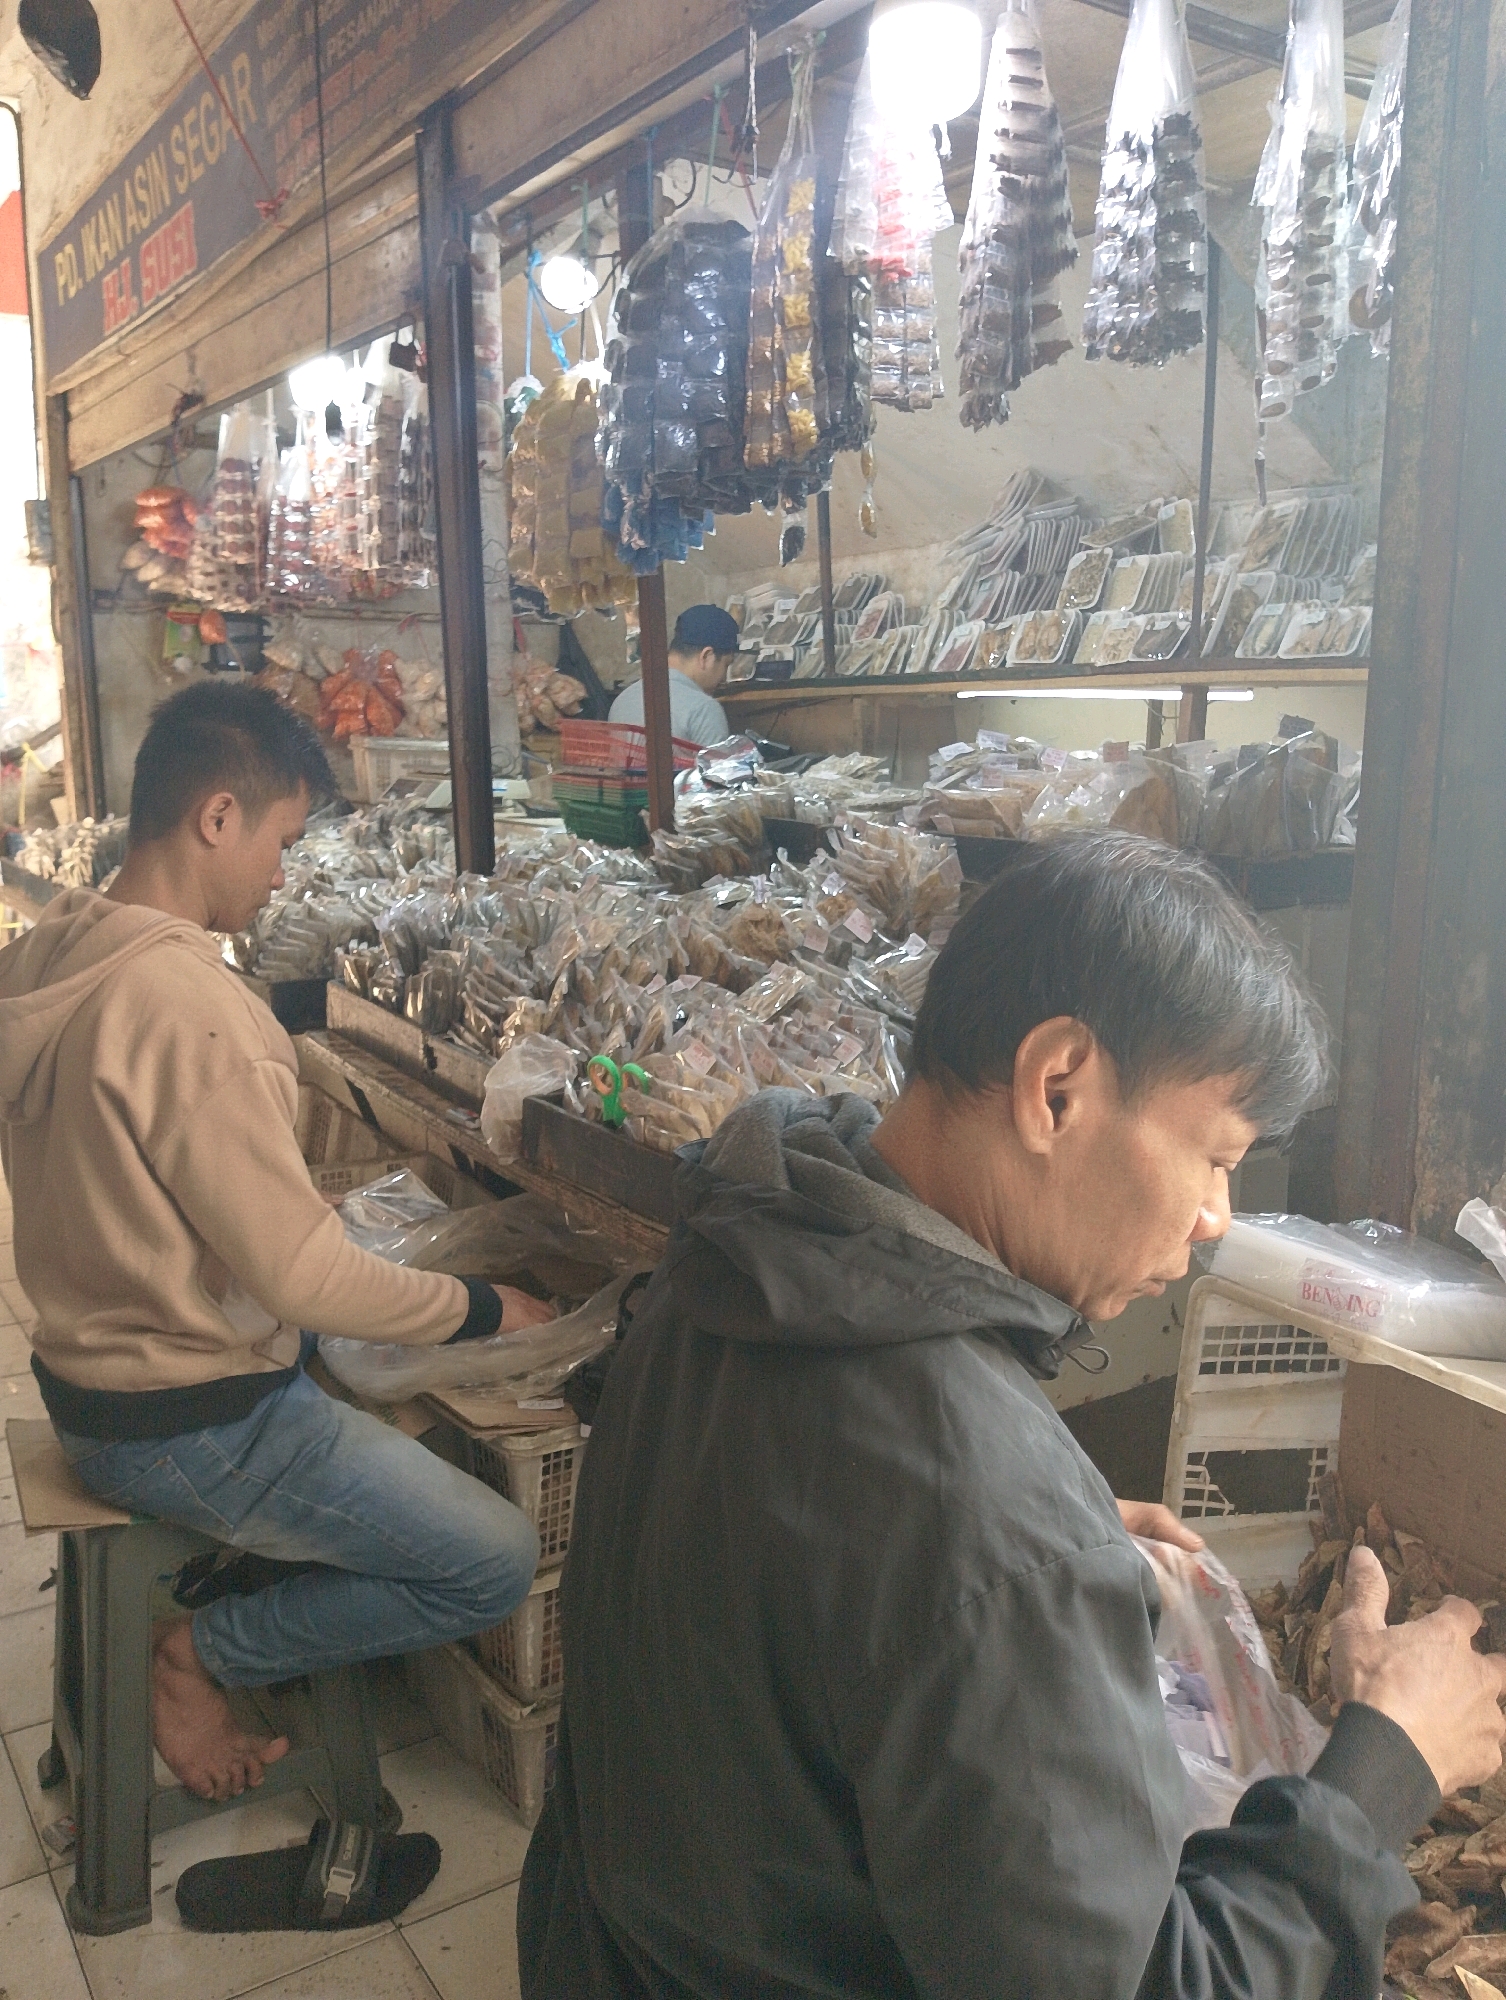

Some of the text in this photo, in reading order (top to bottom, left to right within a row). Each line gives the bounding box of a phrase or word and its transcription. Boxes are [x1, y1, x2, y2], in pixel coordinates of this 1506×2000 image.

[54, 51, 258, 306] PD. IKAN ASIN SEGAR
